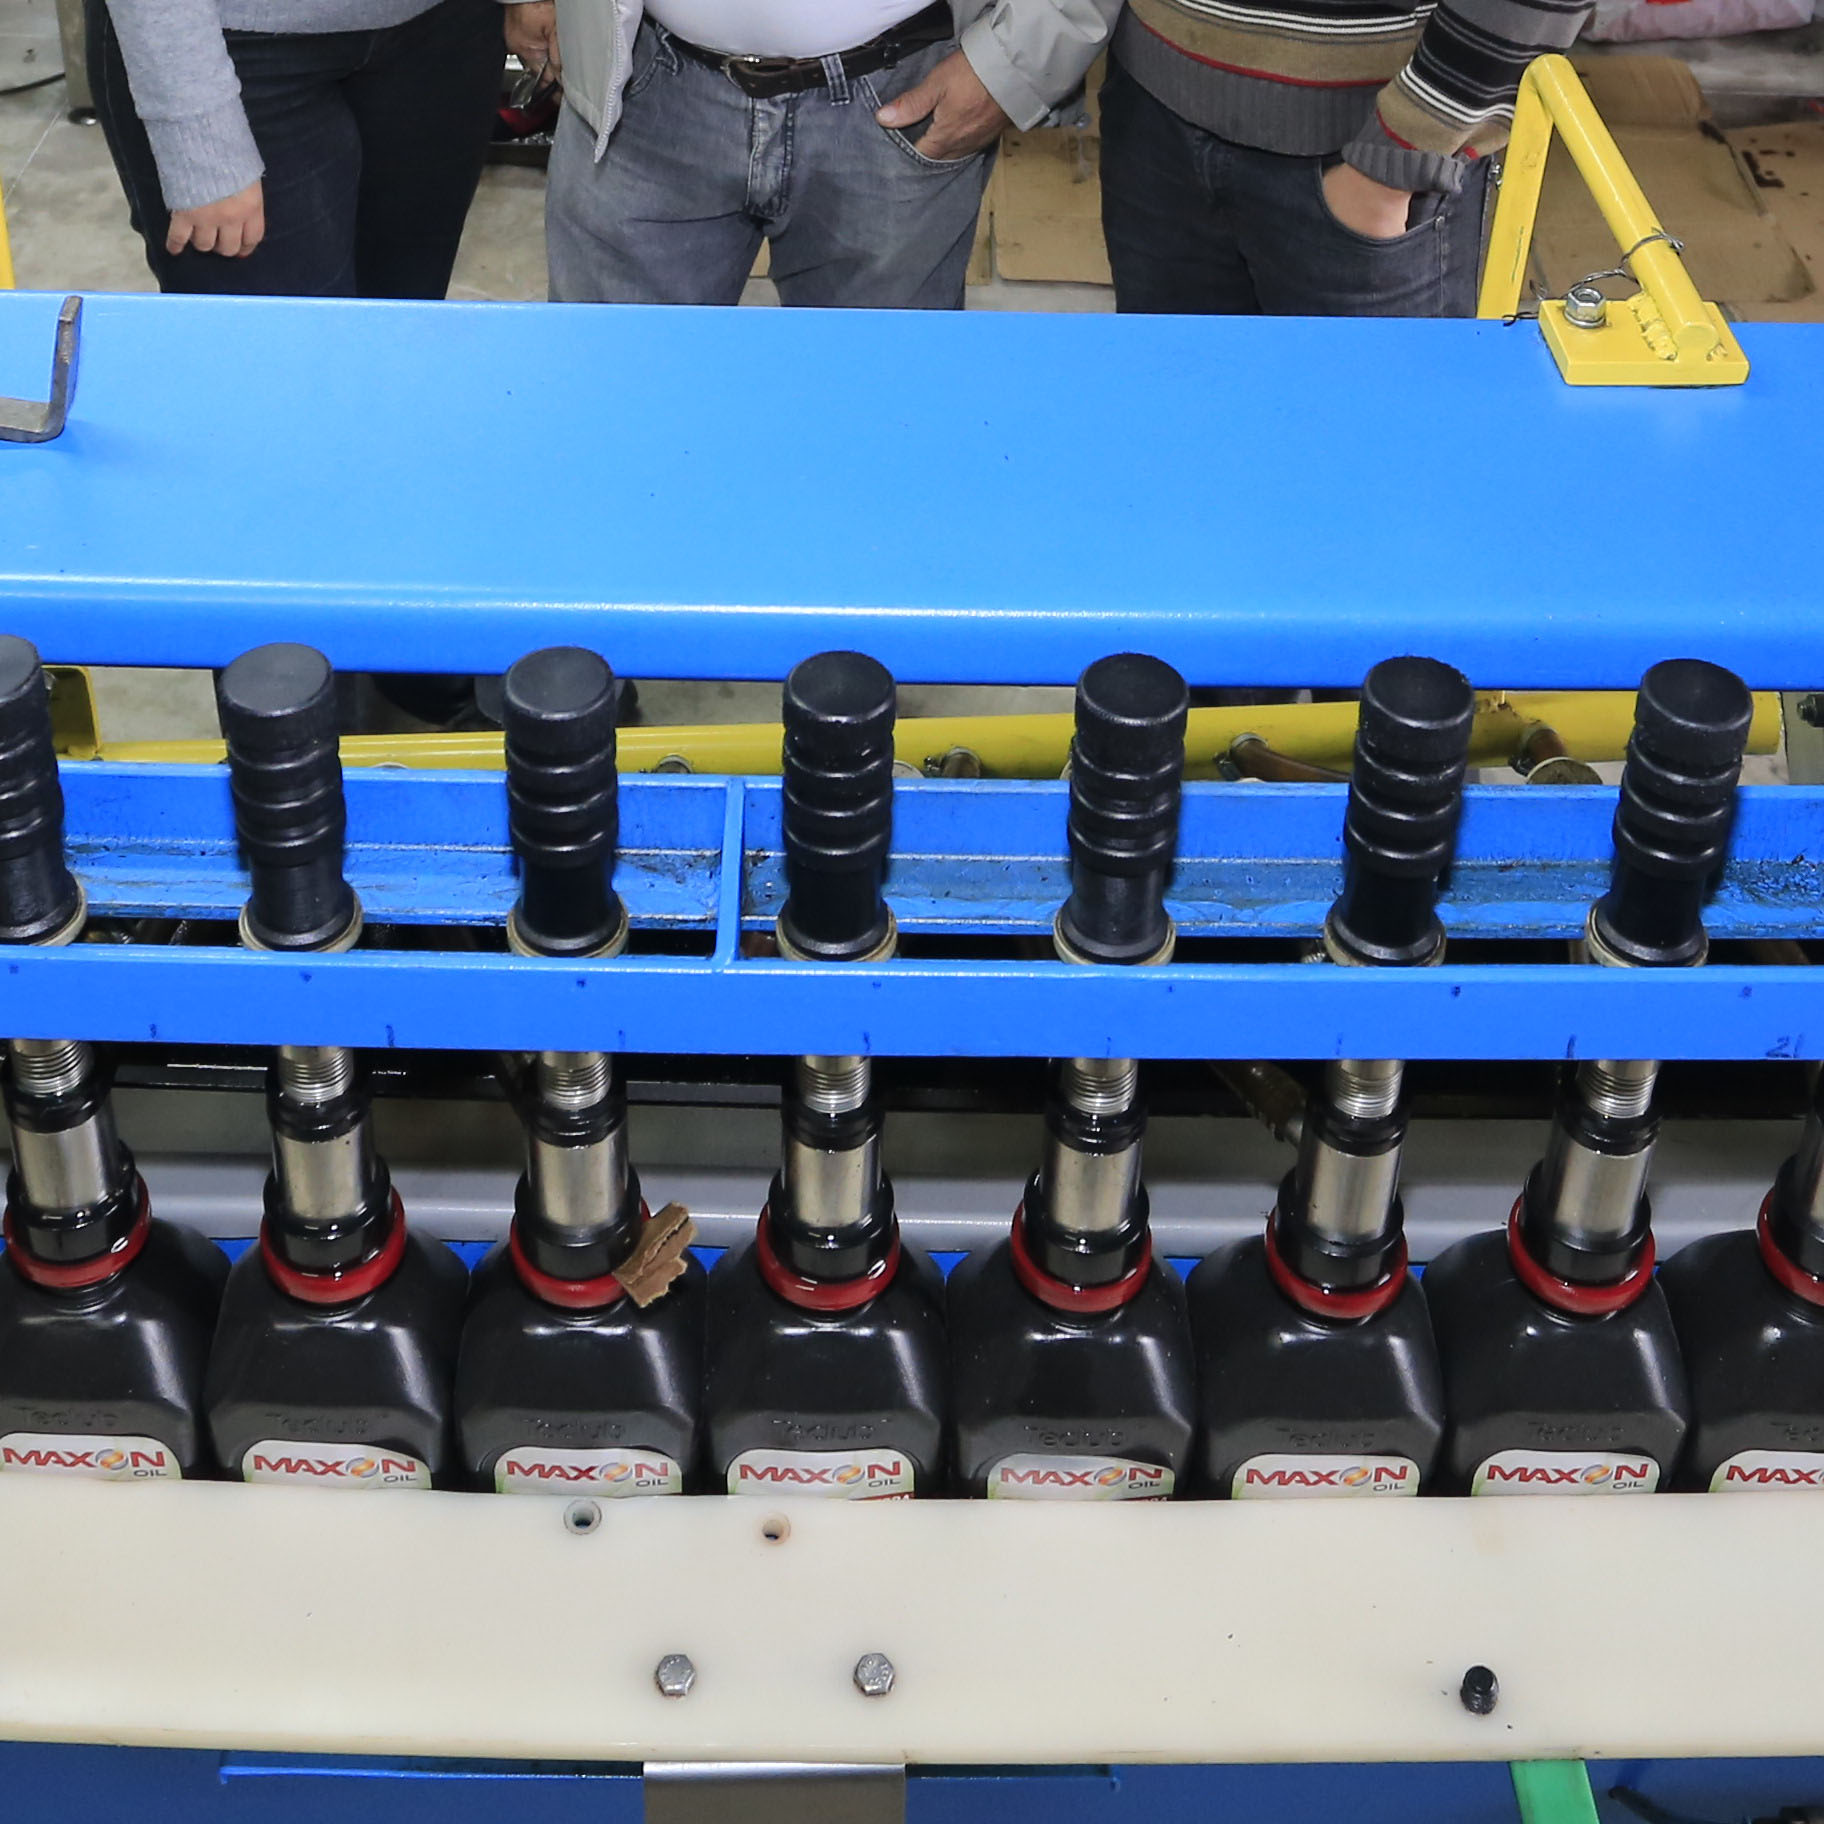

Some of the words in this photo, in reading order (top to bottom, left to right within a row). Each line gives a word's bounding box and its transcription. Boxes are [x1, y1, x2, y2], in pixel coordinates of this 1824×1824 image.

[2, 1447, 166, 1471] MAXON
[253, 1455, 417, 1478] MAXON
[383, 1474, 417, 1483] OIL
[506, 1460, 669, 1483] MAXON
[739, 1461, 901, 1485] MAXON
[1001, 1466, 1163, 1487] MAXON
[1246, 1465, 1409, 1487] MAXON
[1487, 1463, 1650, 1485] MAXON
[635, 1479, 669, 1487] OIL
[868, 1478, 902, 1488] OIL
[1128, 1481, 1161, 1490] OIL
[1372, 1483, 1405, 1492] OIL
[1612, 1480, 1645, 1490] OIL
